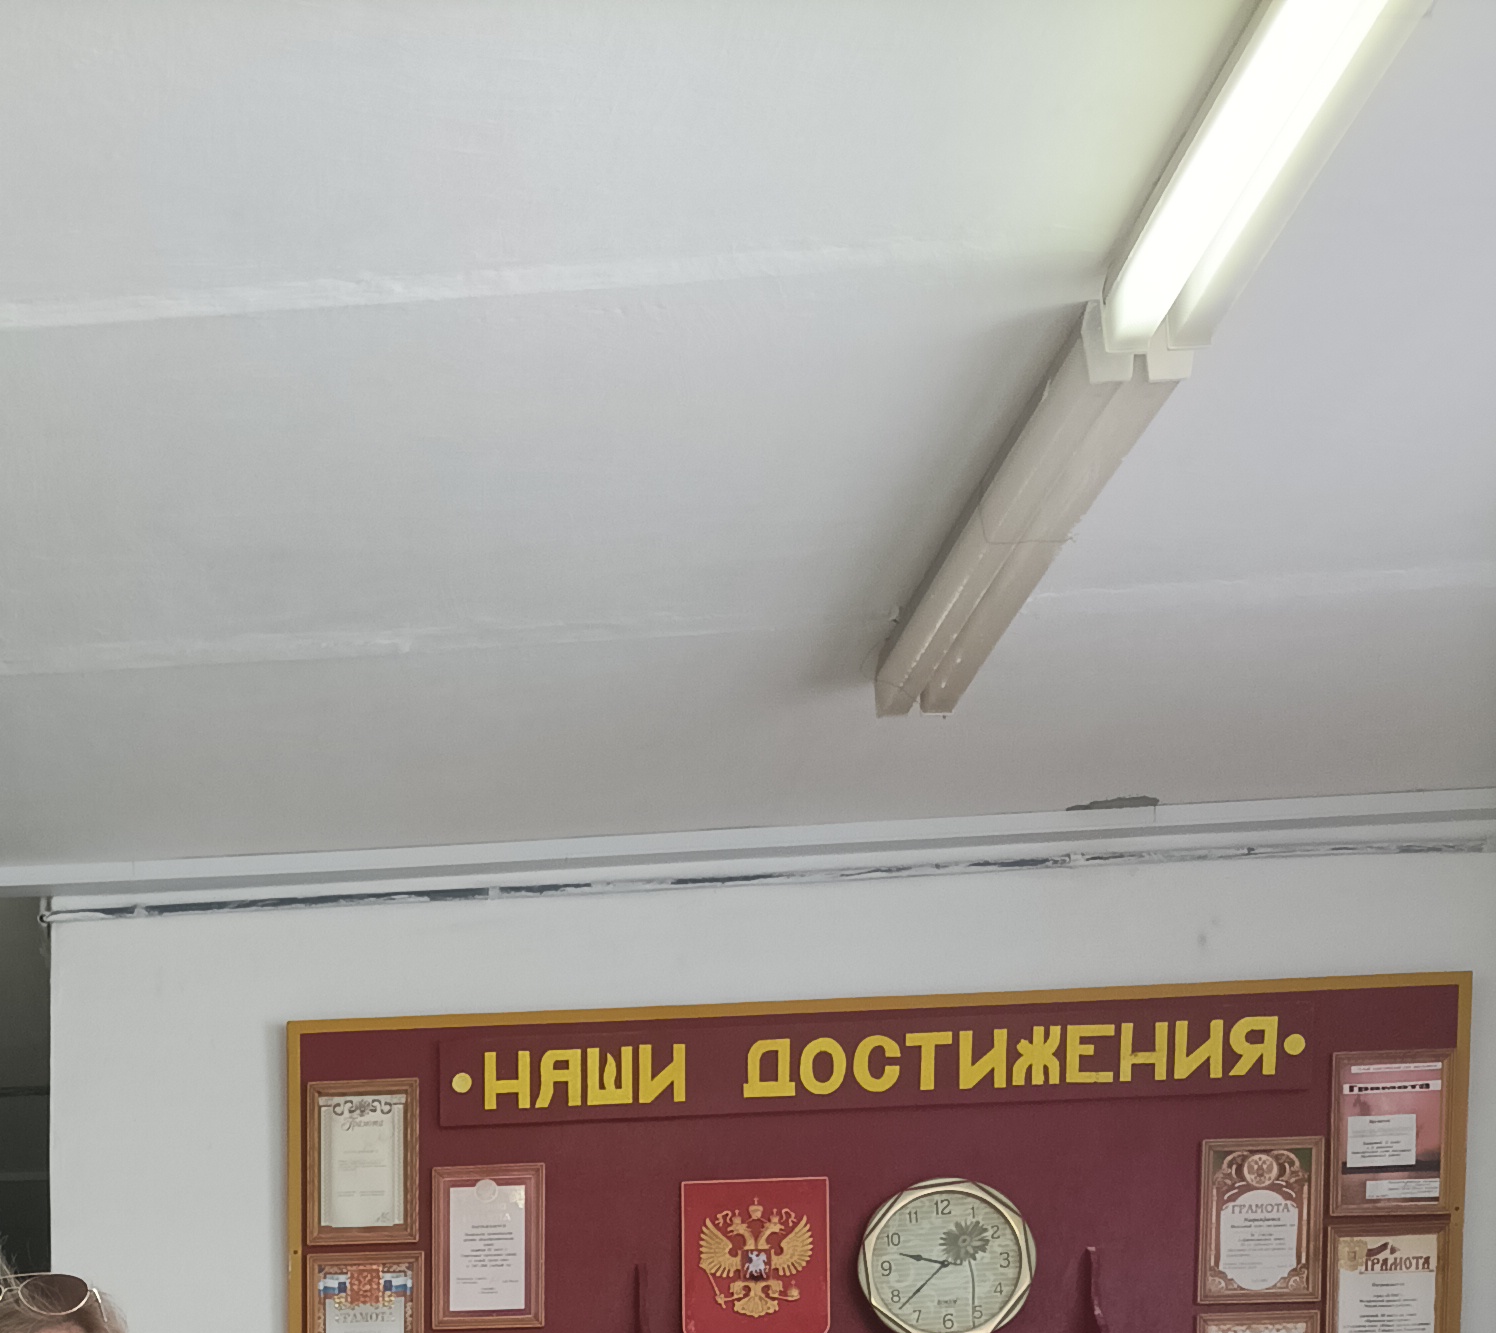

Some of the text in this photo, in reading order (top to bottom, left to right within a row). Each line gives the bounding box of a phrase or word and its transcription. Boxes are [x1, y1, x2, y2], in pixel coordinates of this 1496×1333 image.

[484, 1016, 1279, 1110] НАШИ ДОСТИЖЕНИЯ
[934, 1199, 952, 1215] 12
[1231, 1203, 1291, 1215] ГРАМОТА
[907, 1210, 919, 1224] 11
[886, 1232, 901, 1247] 10
[990, 1225, 1001, 1240] 2
[999, 1252, 1011, 1269] 3
[1363, 1255, 1431, 1272] ГРАМОТА
[880, 1260, 892, 1277] 9
[890, 1289, 901, 1303] 8
[994, 1282, 1003, 1295] 4
[913, 1309, 922, 1323] 7
[973, 1305, 983, 1319] 5
[942, 1313, 954, 1330] 6
